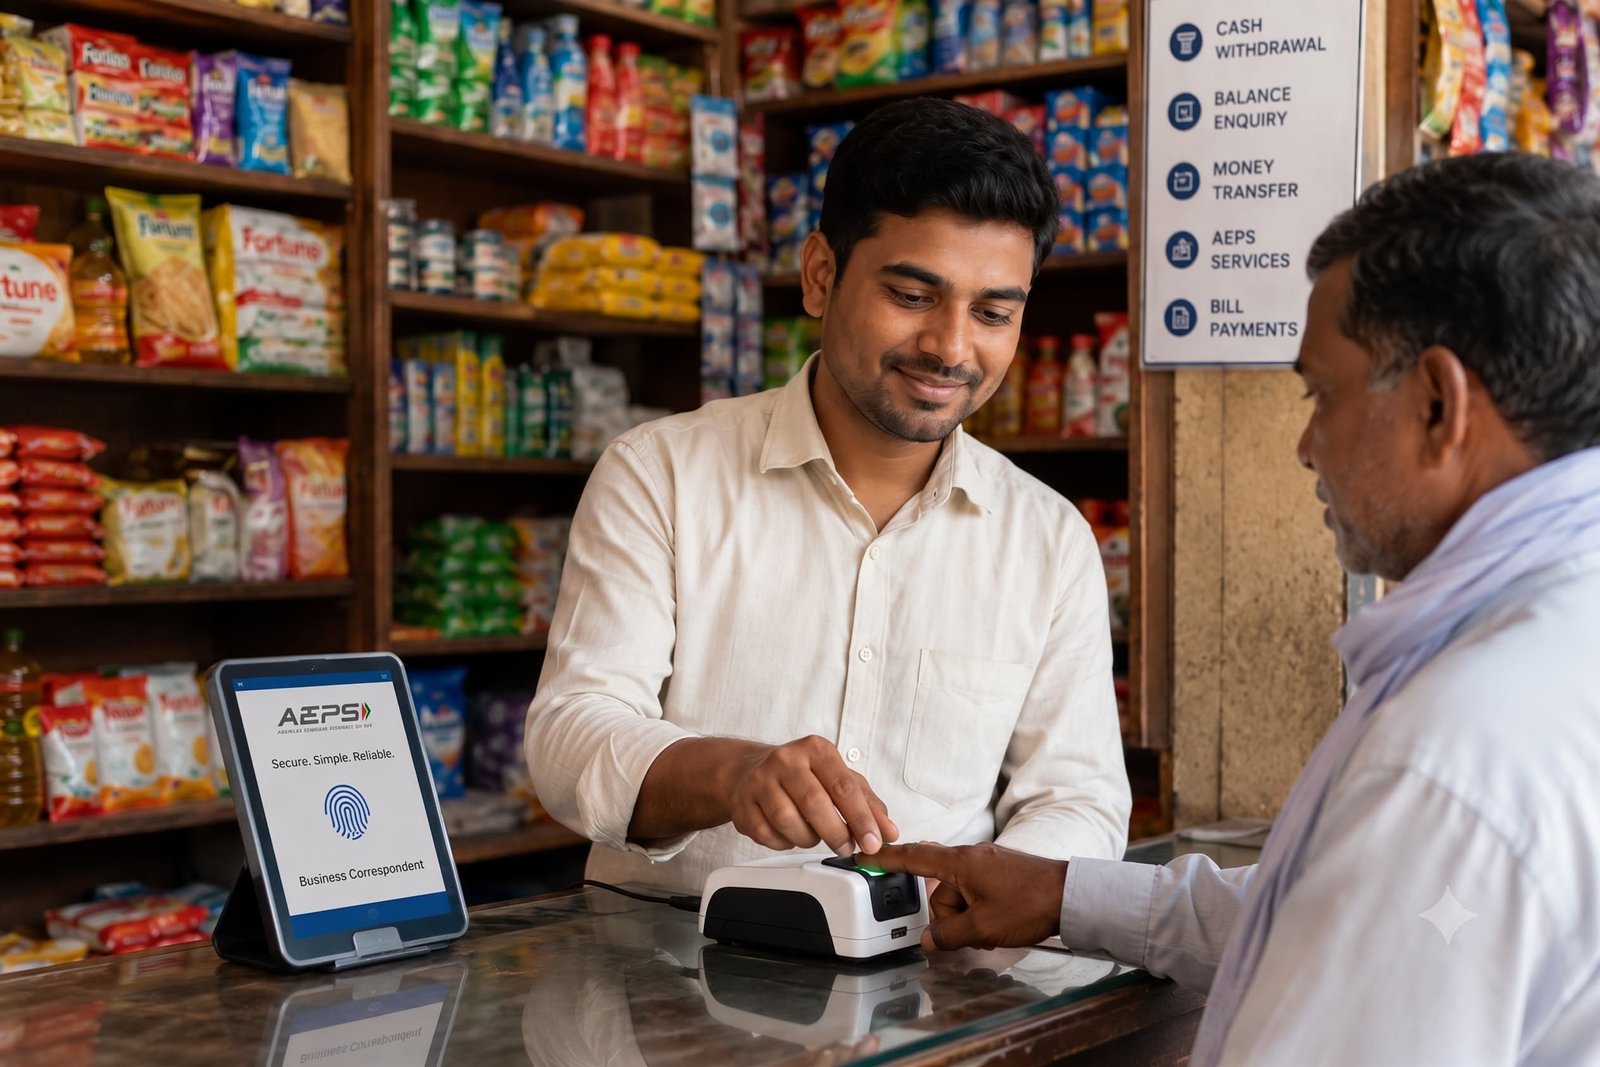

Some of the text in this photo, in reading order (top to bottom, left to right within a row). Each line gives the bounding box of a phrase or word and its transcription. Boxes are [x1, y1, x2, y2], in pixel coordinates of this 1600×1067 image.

[1216, 18, 1263, 36] CASH
[1216, 37, 1326, 59] WITHDRAWAL
[1214, 87, 1291, 106] BALANCE
[1214, 111, 1288, 130] ENQUIRY
[1213, 159, 1275, 176] MONEY
[1213, 183, 1299, 200] TRANSFER
[1211, 230, 1256, 245] AEPS
[1211, 253, 1291, 269] SERVICES
[1210, 299, 1244, 314] BILL
[1210, 322, 1299, 337] PAYMENTS
[277, 702, 360, 727] AEPS
[271, 748, 395, 770] Secure. Simple. Reliable.
[299, 859, 425, 887] Business Correspondent
